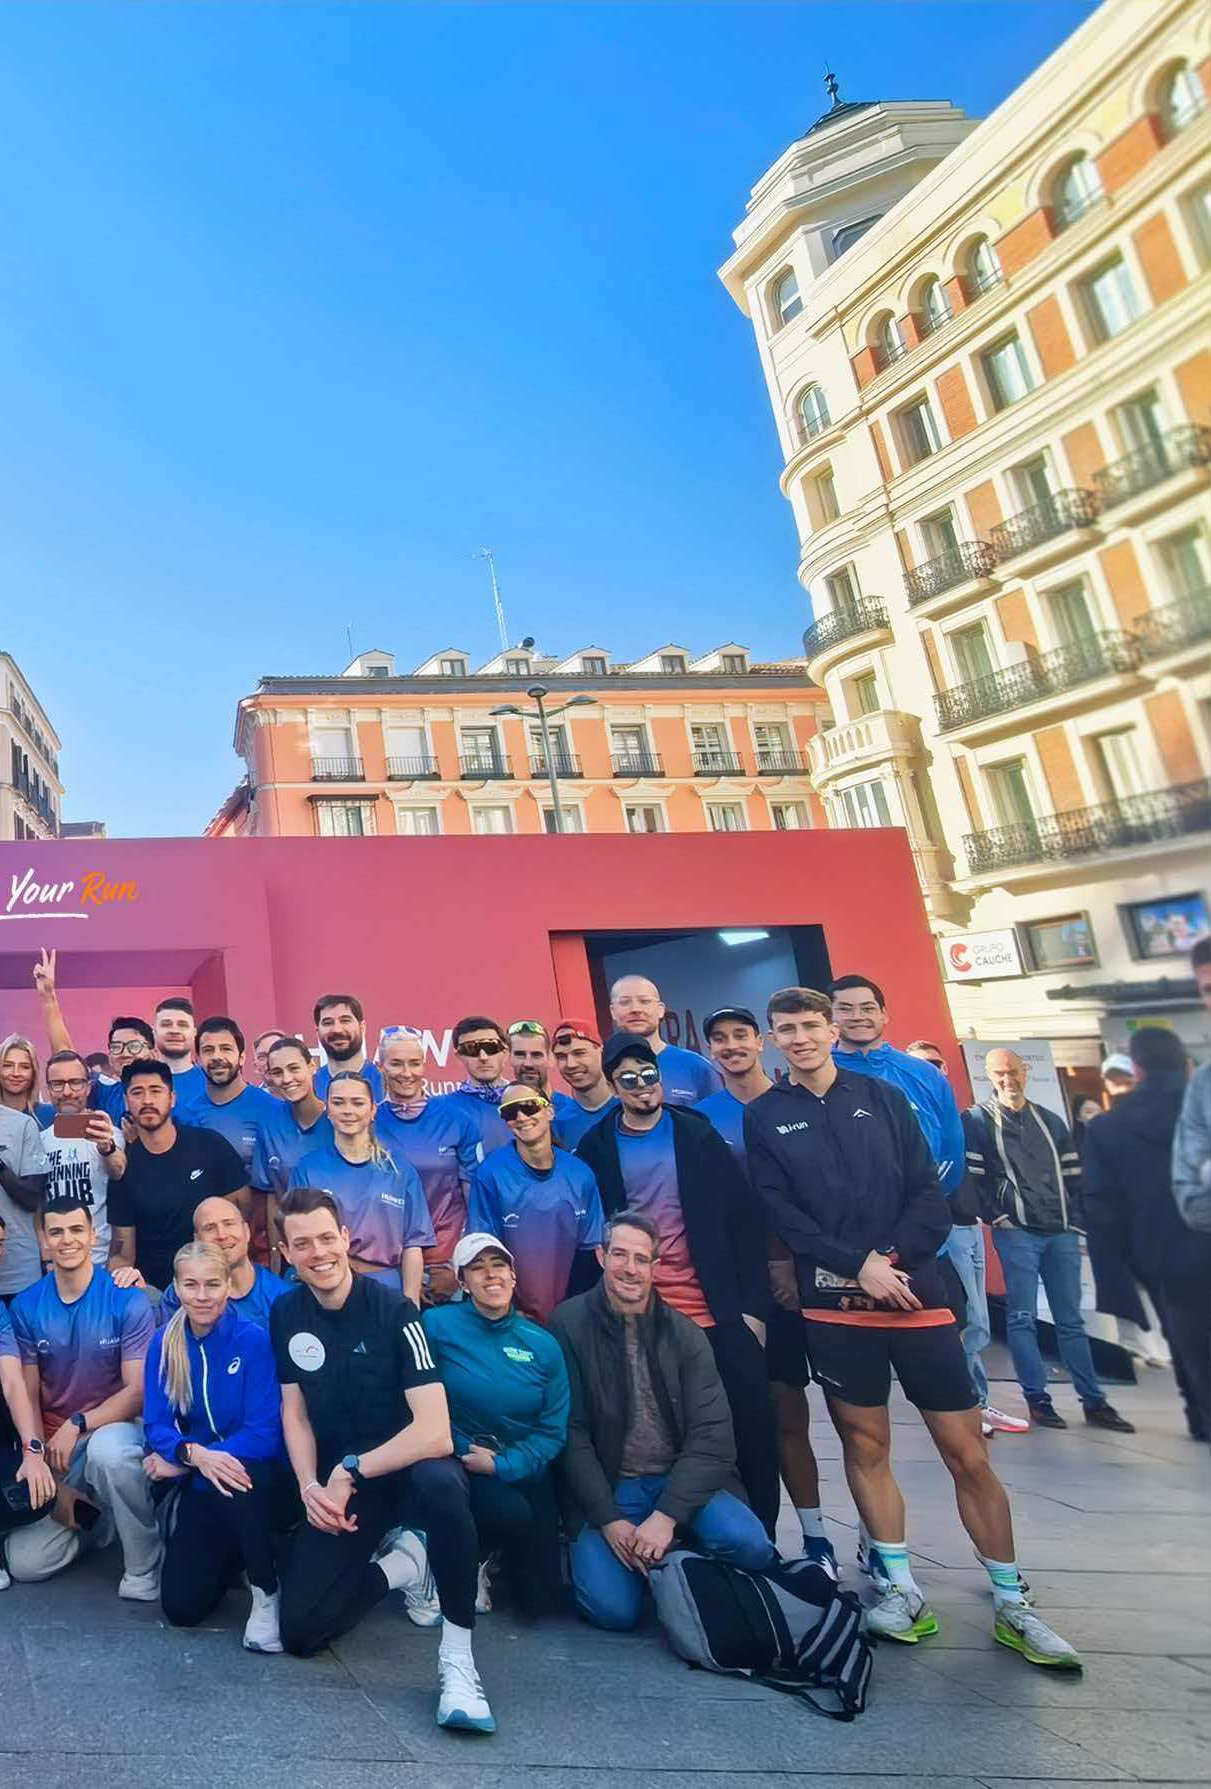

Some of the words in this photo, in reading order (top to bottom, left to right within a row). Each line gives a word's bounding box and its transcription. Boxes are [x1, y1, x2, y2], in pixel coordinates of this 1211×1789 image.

[6, 868, 75, 912] Your
[80, 870, 136, 906] Run
[46, 1150, 62, 1166] HE
[50, 1162, 91, 1181] UNNING
